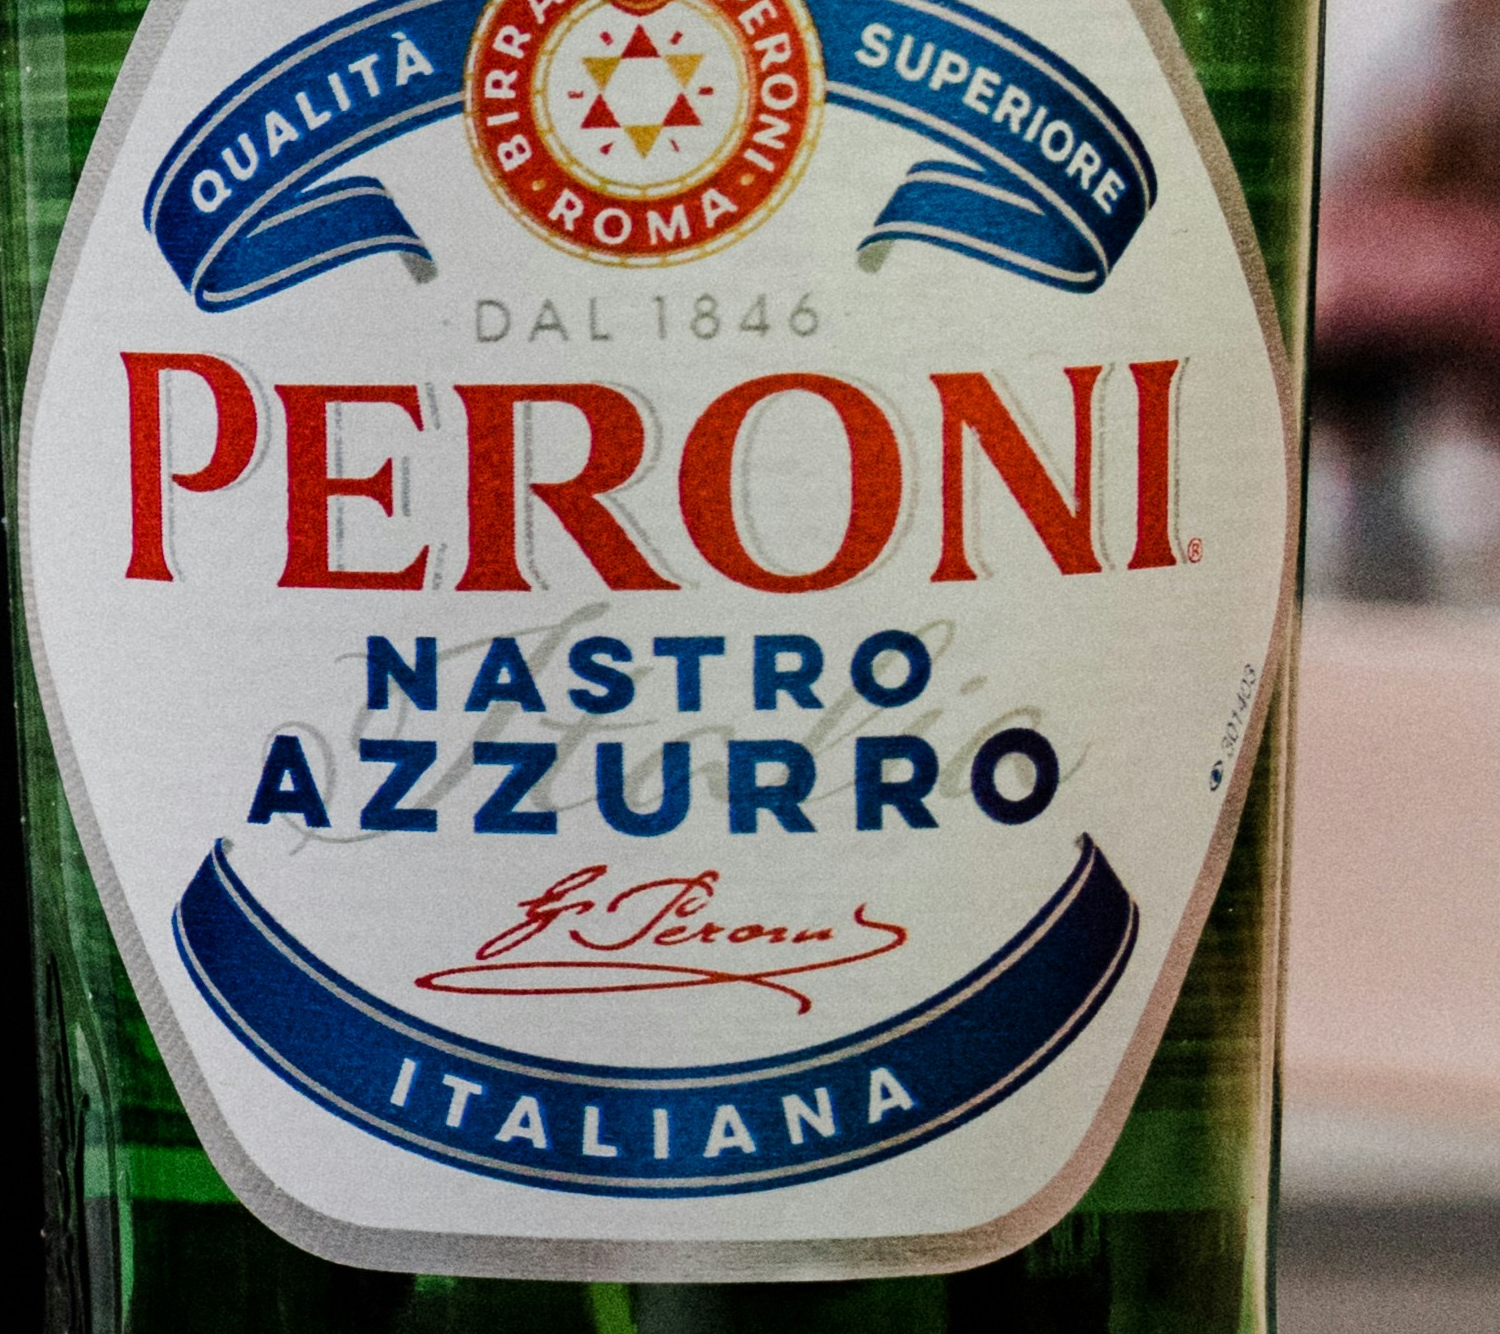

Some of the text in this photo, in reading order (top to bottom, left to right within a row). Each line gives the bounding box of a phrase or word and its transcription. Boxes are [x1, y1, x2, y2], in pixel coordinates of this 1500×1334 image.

[191, 30, 435, 213] QUALITÀ
[853, 22, 1127, 215] SUPERIORE
[547, 187, 738, 246] ROMA
[474, 292, 820, 344] DAL 1846
[365, 628, 933, 716] NASTRO
[246, 726, 1061, 838] AZZURRO
[388, 1057, 919, 1160] ITALIANA
